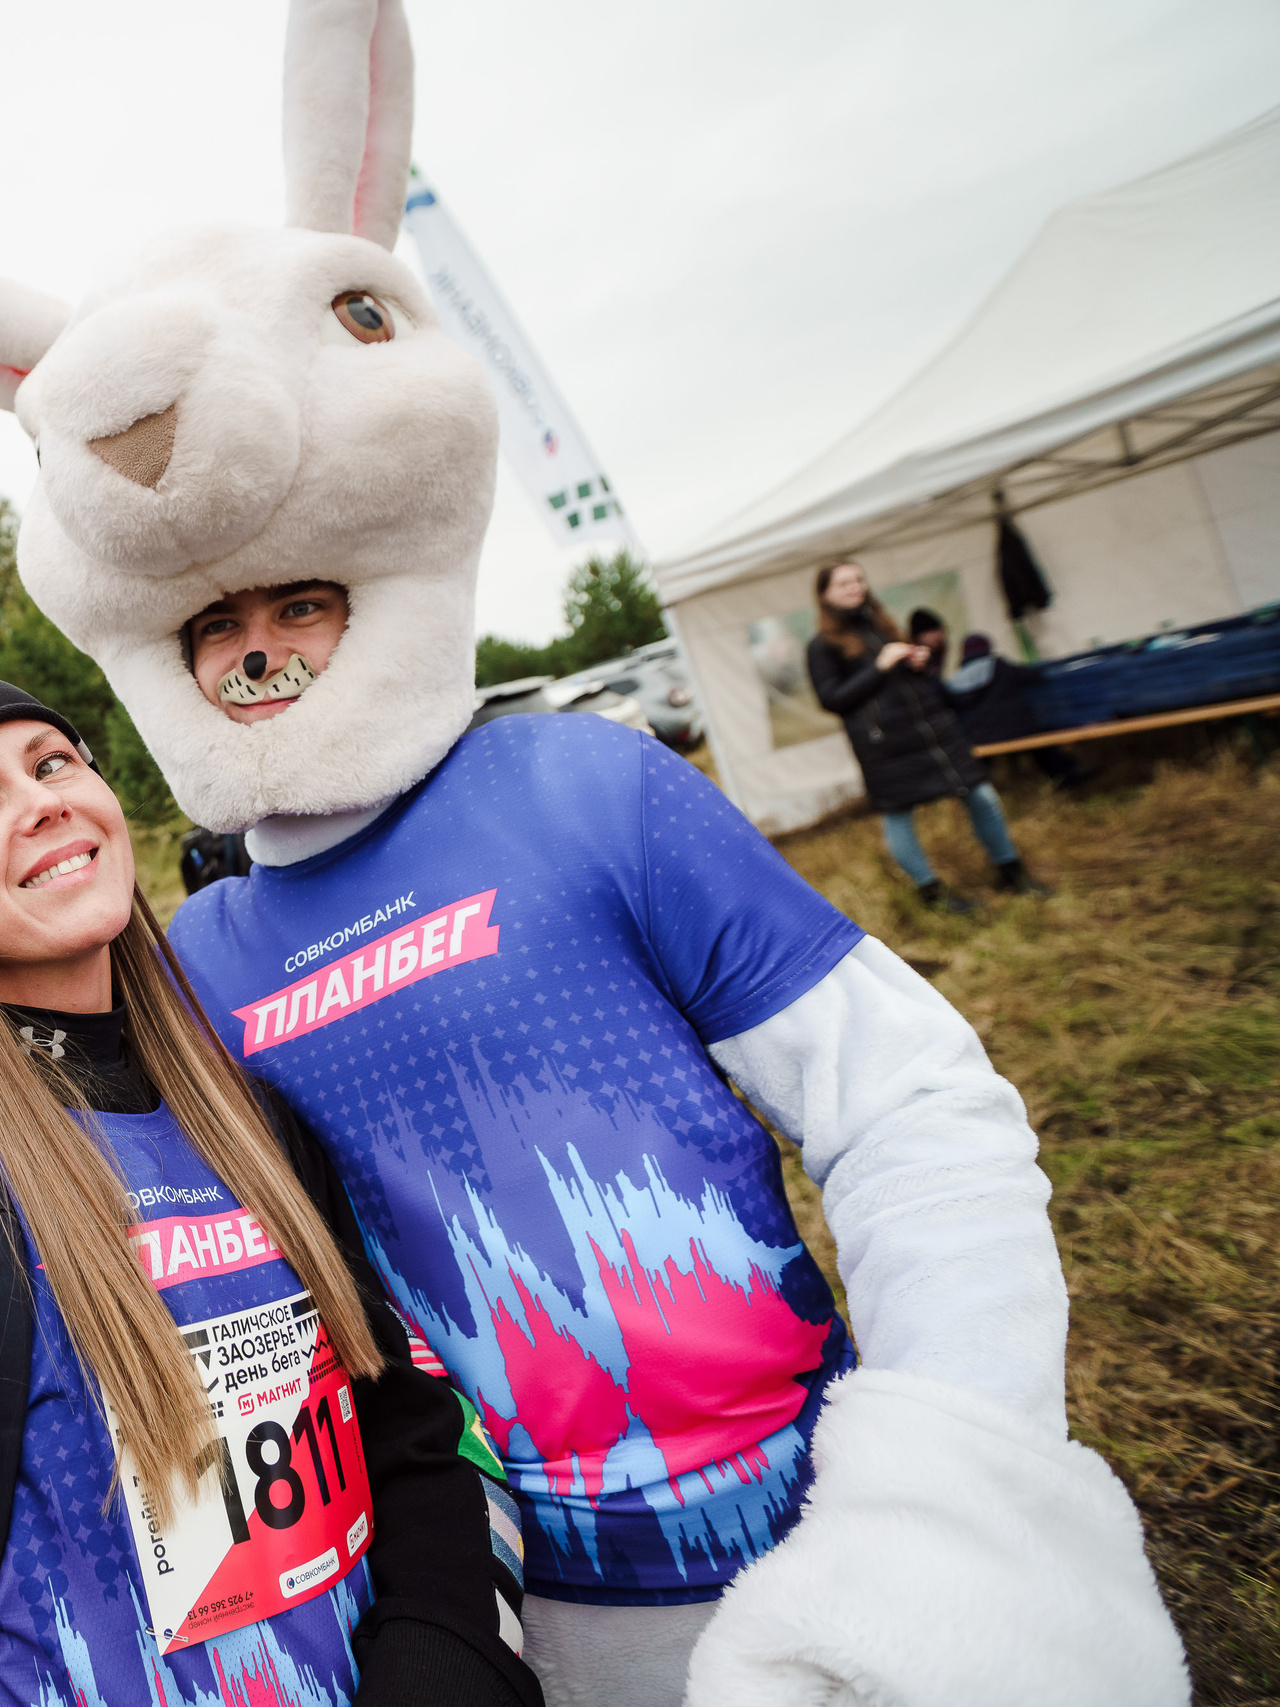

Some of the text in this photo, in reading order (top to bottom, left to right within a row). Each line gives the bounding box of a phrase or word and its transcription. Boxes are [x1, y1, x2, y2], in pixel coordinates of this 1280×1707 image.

[284, 890, 417, 973] СОВКОМБАНК
[252, 902, 481, 1045] ПЛАНБЕГ
[126, 1185, 224, 1209] ОВКОМБАНК
[128, 1214, 279, 1281] ЛАНБЕ
[212, 1304, 291, 1343] ГАЛИЧСКОЕ
[218, 1324, 296, 1366] ЗАОЗЕРЬЕ
[224, 1350, 301, 1393] день бега
[257, 1378, 303, 1404] МАГНИТ
[195, 1395, 346, 1545] 1811
[295, 1556, 336, 1585] СОВКОМБАНК
[211, 1600, 227, 1612] 365
[228, 1594, 244, 1606] 925
